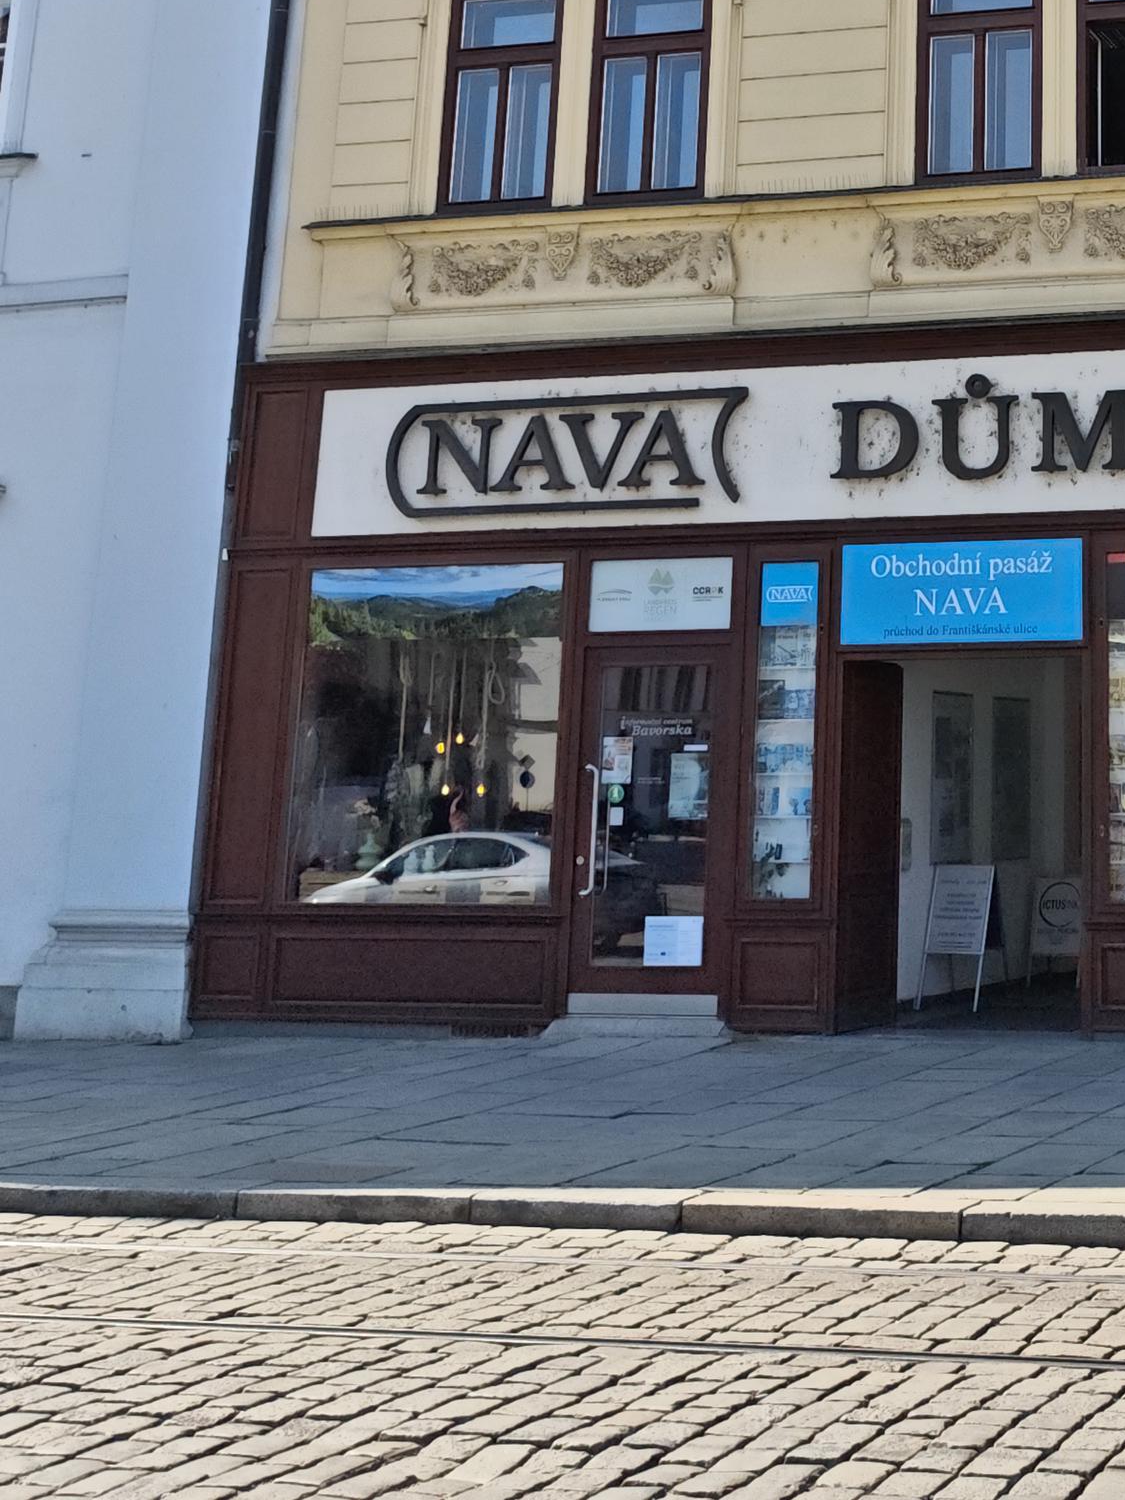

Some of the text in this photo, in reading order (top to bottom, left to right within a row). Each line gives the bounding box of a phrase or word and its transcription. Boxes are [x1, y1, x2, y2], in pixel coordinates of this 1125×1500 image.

[416, 408, 705, 495] NAVA
[870, 549, 1054, 581] Obchodní pasáž
[770, 587, 809, 600] NAVA
[913, 586, 1009, 617] NAVA
[882, 624, 925, 639] průchod
[926, 624, 940, 636] do
[1013, 621, 1039, 635] ulice
[631, 724, 693, 737] Bavorska
